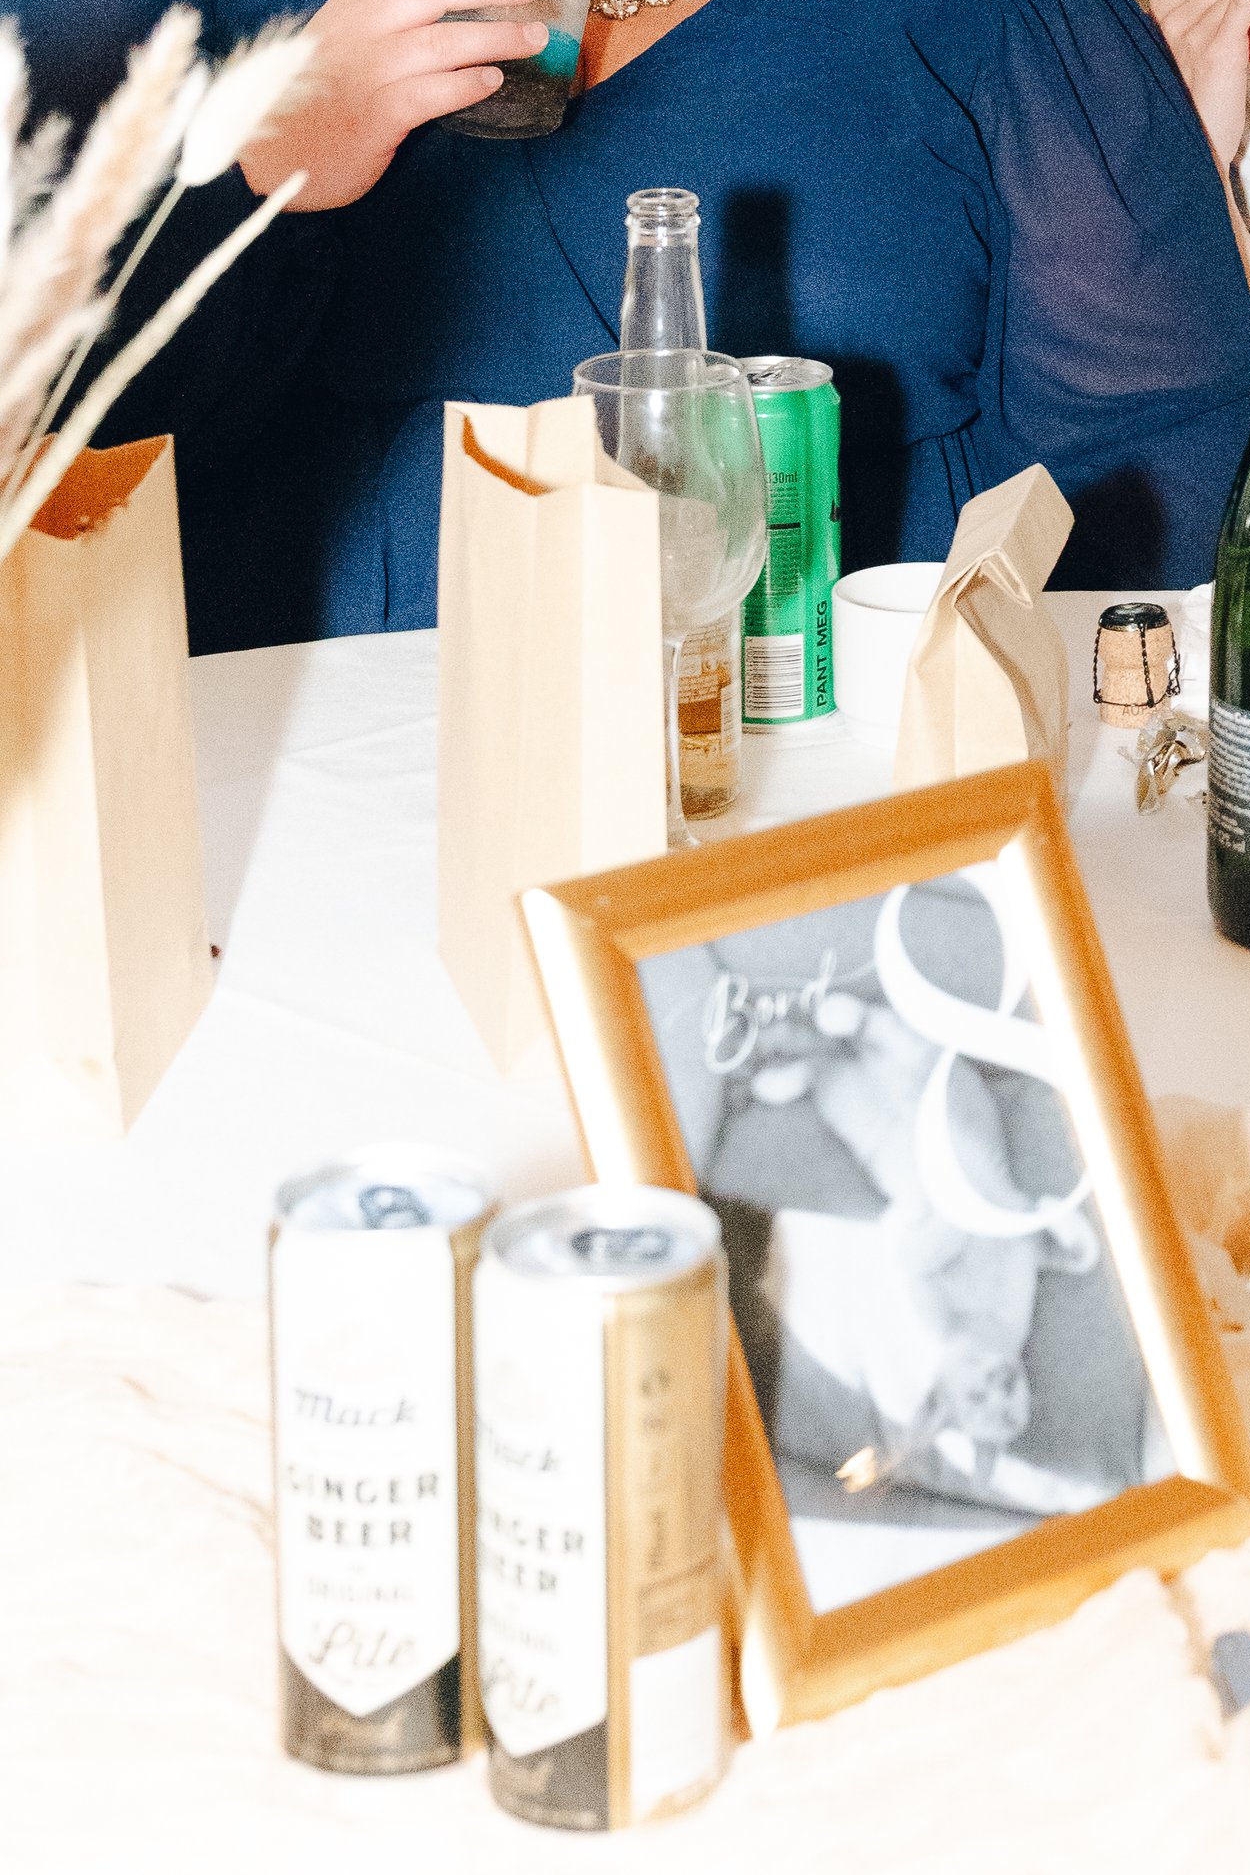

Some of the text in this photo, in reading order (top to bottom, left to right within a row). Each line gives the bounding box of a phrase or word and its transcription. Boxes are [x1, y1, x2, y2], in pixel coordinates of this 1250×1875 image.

[816, 599, 828, 708] PANT MEG
[306, 1512, 413, 1547] BEER
